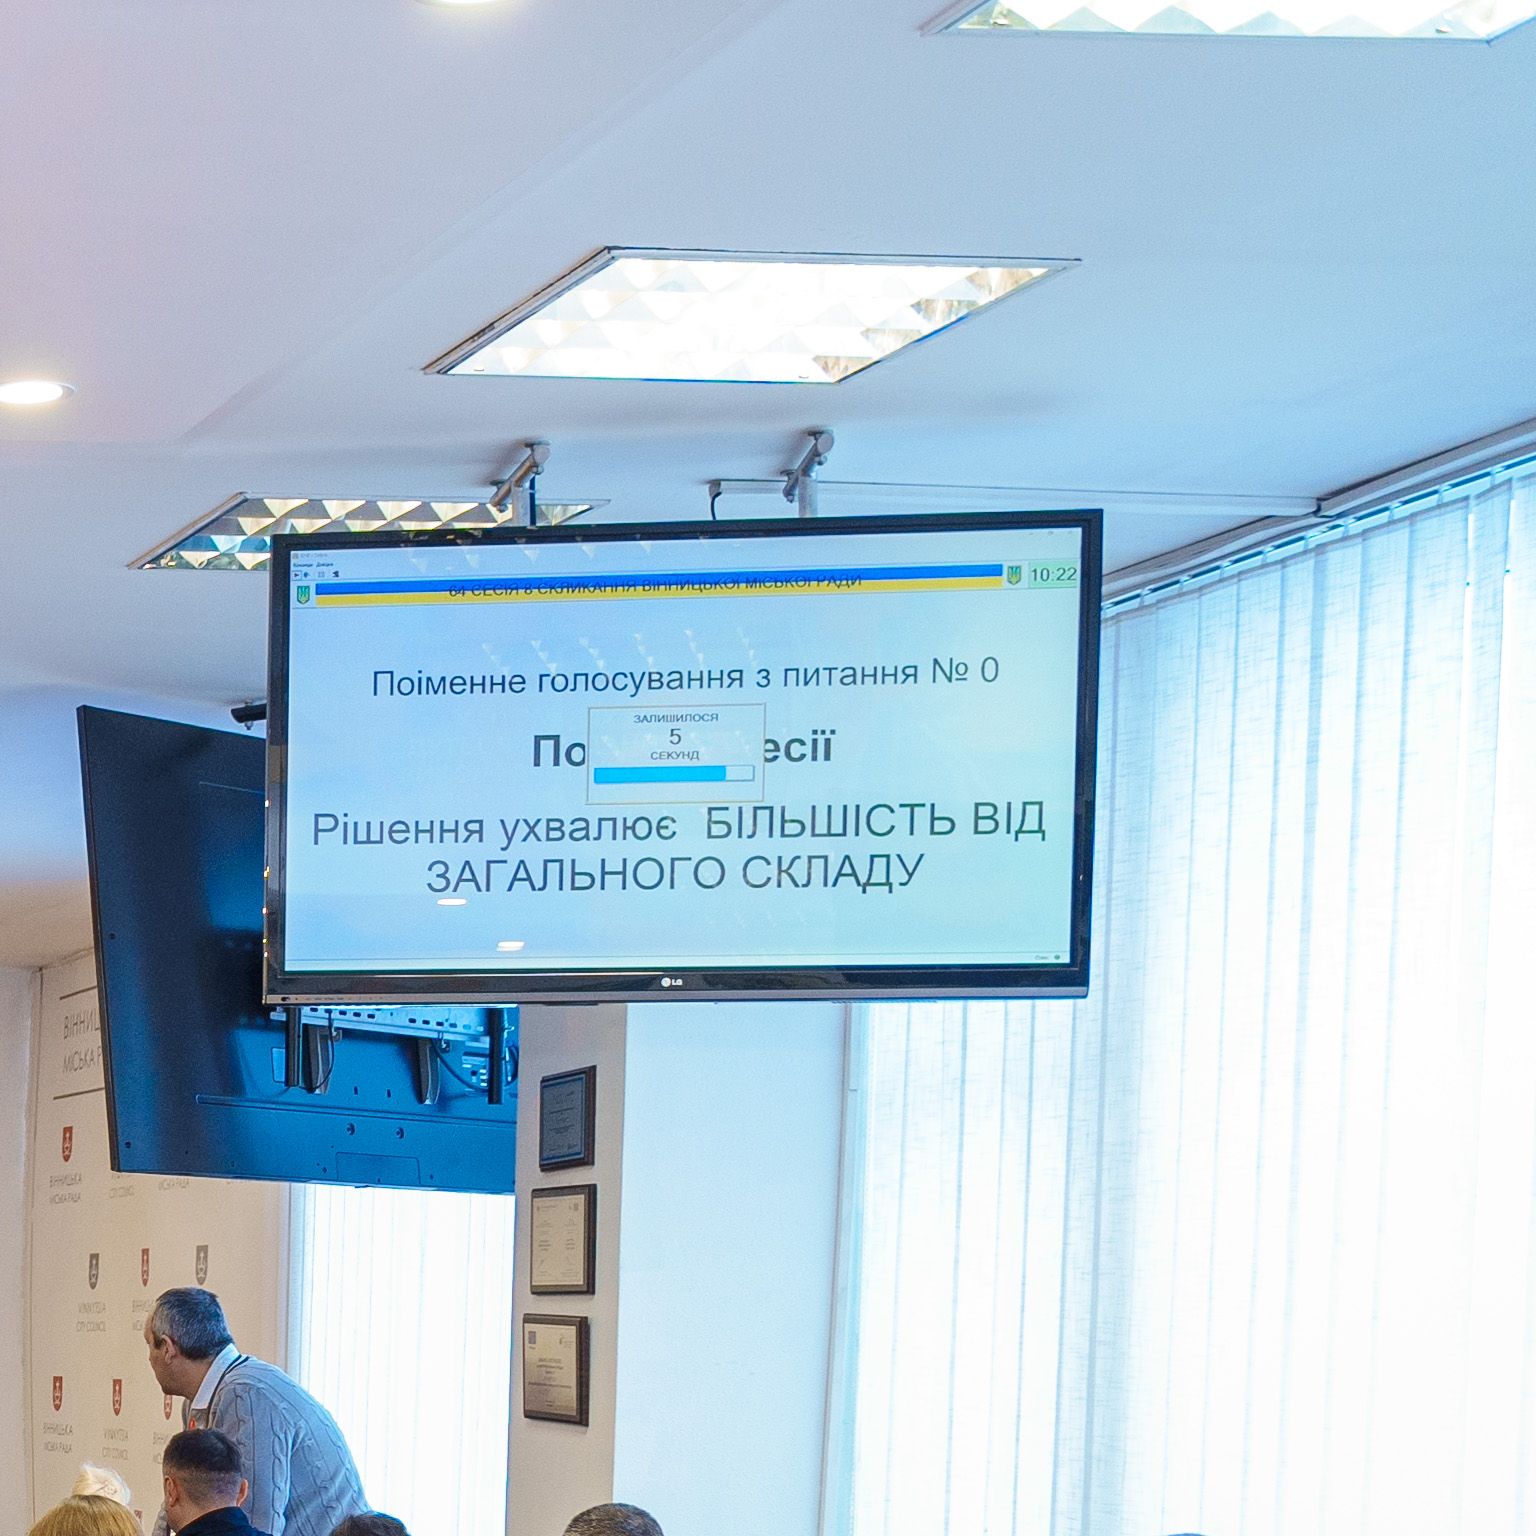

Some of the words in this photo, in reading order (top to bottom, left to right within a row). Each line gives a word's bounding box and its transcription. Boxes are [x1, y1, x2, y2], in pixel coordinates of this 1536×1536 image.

[471, 582, 519, 597] СЕСІЯ
[537, 579, 637, 595] СКЛИКАННЯ
[817, 574, 862, 589] РАДИ
[1030, 566, 1077, 582] 10:22
[373, 669, 527, 697] Поіменне
[538, 667, 744, 698] голосування
[756, 668, 771, 688] з
[783, 664, 919, 688] питання
[931, 656, 969, 684] №
[980, 656, 999, 683] 0
[633, 713, 719, 724] ЗАЛИШИЛОСЯ
[532, 734, 586, 768] По
[763, 728, 837, 764] есії
[669, 728, 682, 745] 5
[650, 750, 700, 762] СЕКУНД
[313, 812, 485, 846] Рішення
[499, 815, 677, 851] ухвалює
[706, 802, 956, 840] БІЛЬШІСТЬ
[973, 800, 1046, 842] ВІД
[426, 855, 726, 893] ЗАГАЛЬНОГО
[741, 853, 925, 894] СКЛАДУ
[63, 1008, 100, 1040] ВІННИЦ
